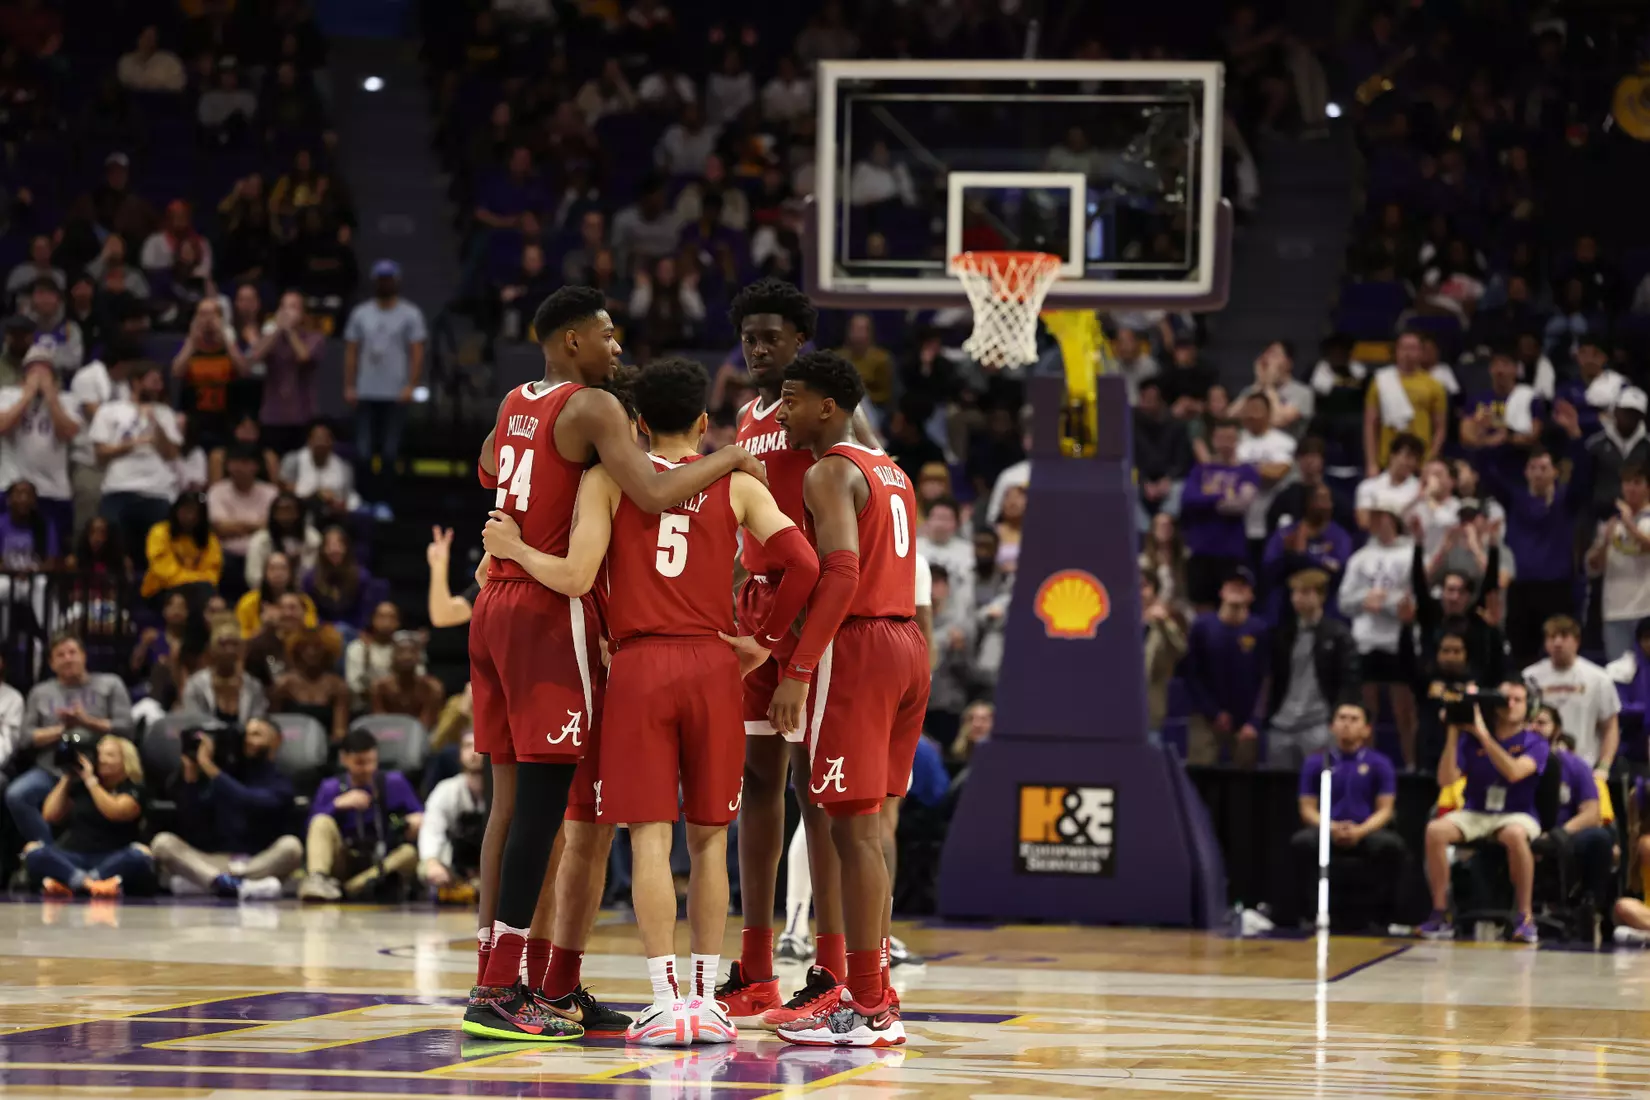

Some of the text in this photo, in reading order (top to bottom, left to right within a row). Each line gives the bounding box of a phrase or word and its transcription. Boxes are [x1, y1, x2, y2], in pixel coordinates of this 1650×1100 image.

[507, 414, 539, 441] MILLER
[496, 444, 535, 512] 24
[655, 512, 690, 578] 5
[890, 494, 909, 558] 0
[1019, 786, 1114, 845] H&E
